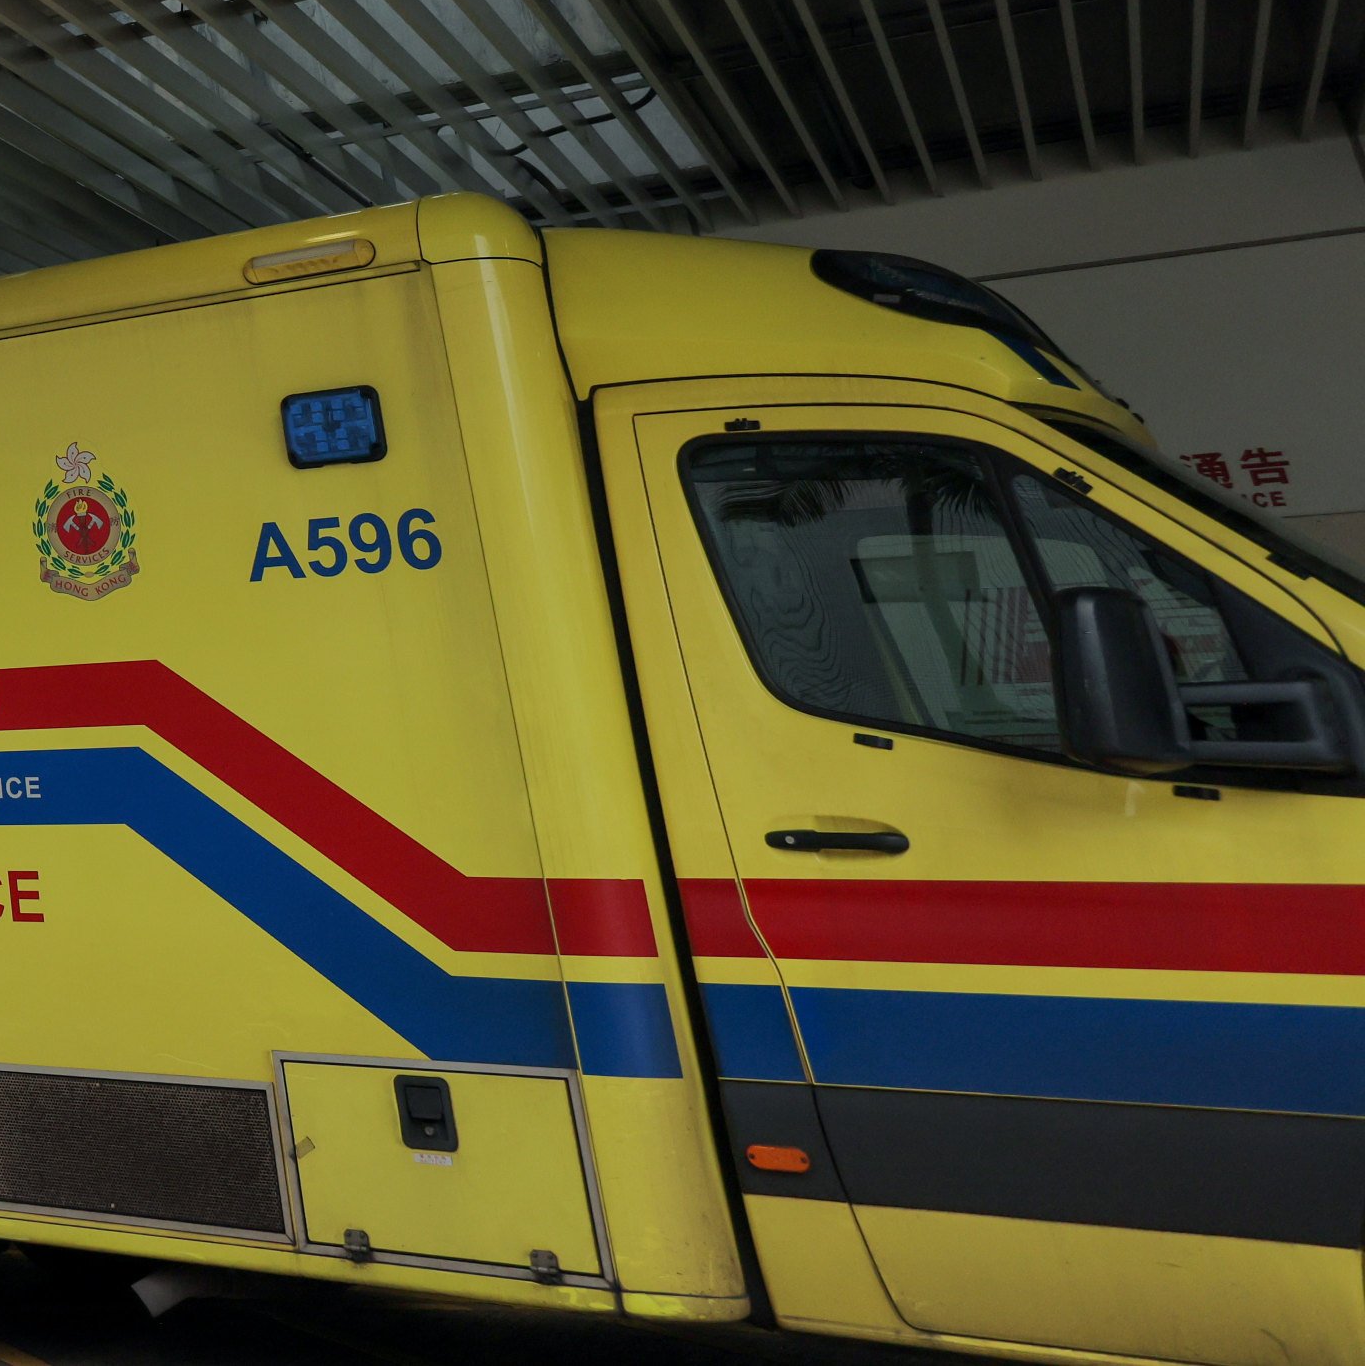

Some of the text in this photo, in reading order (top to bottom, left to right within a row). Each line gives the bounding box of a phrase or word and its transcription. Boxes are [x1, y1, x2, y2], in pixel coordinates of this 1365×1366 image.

[66, 488, 91, 499] FIRE
[249, 508, 443, 582] A596
[63, 547, 110, 564] SERVICES
[54, 574, 126, 597] HONG KONG
